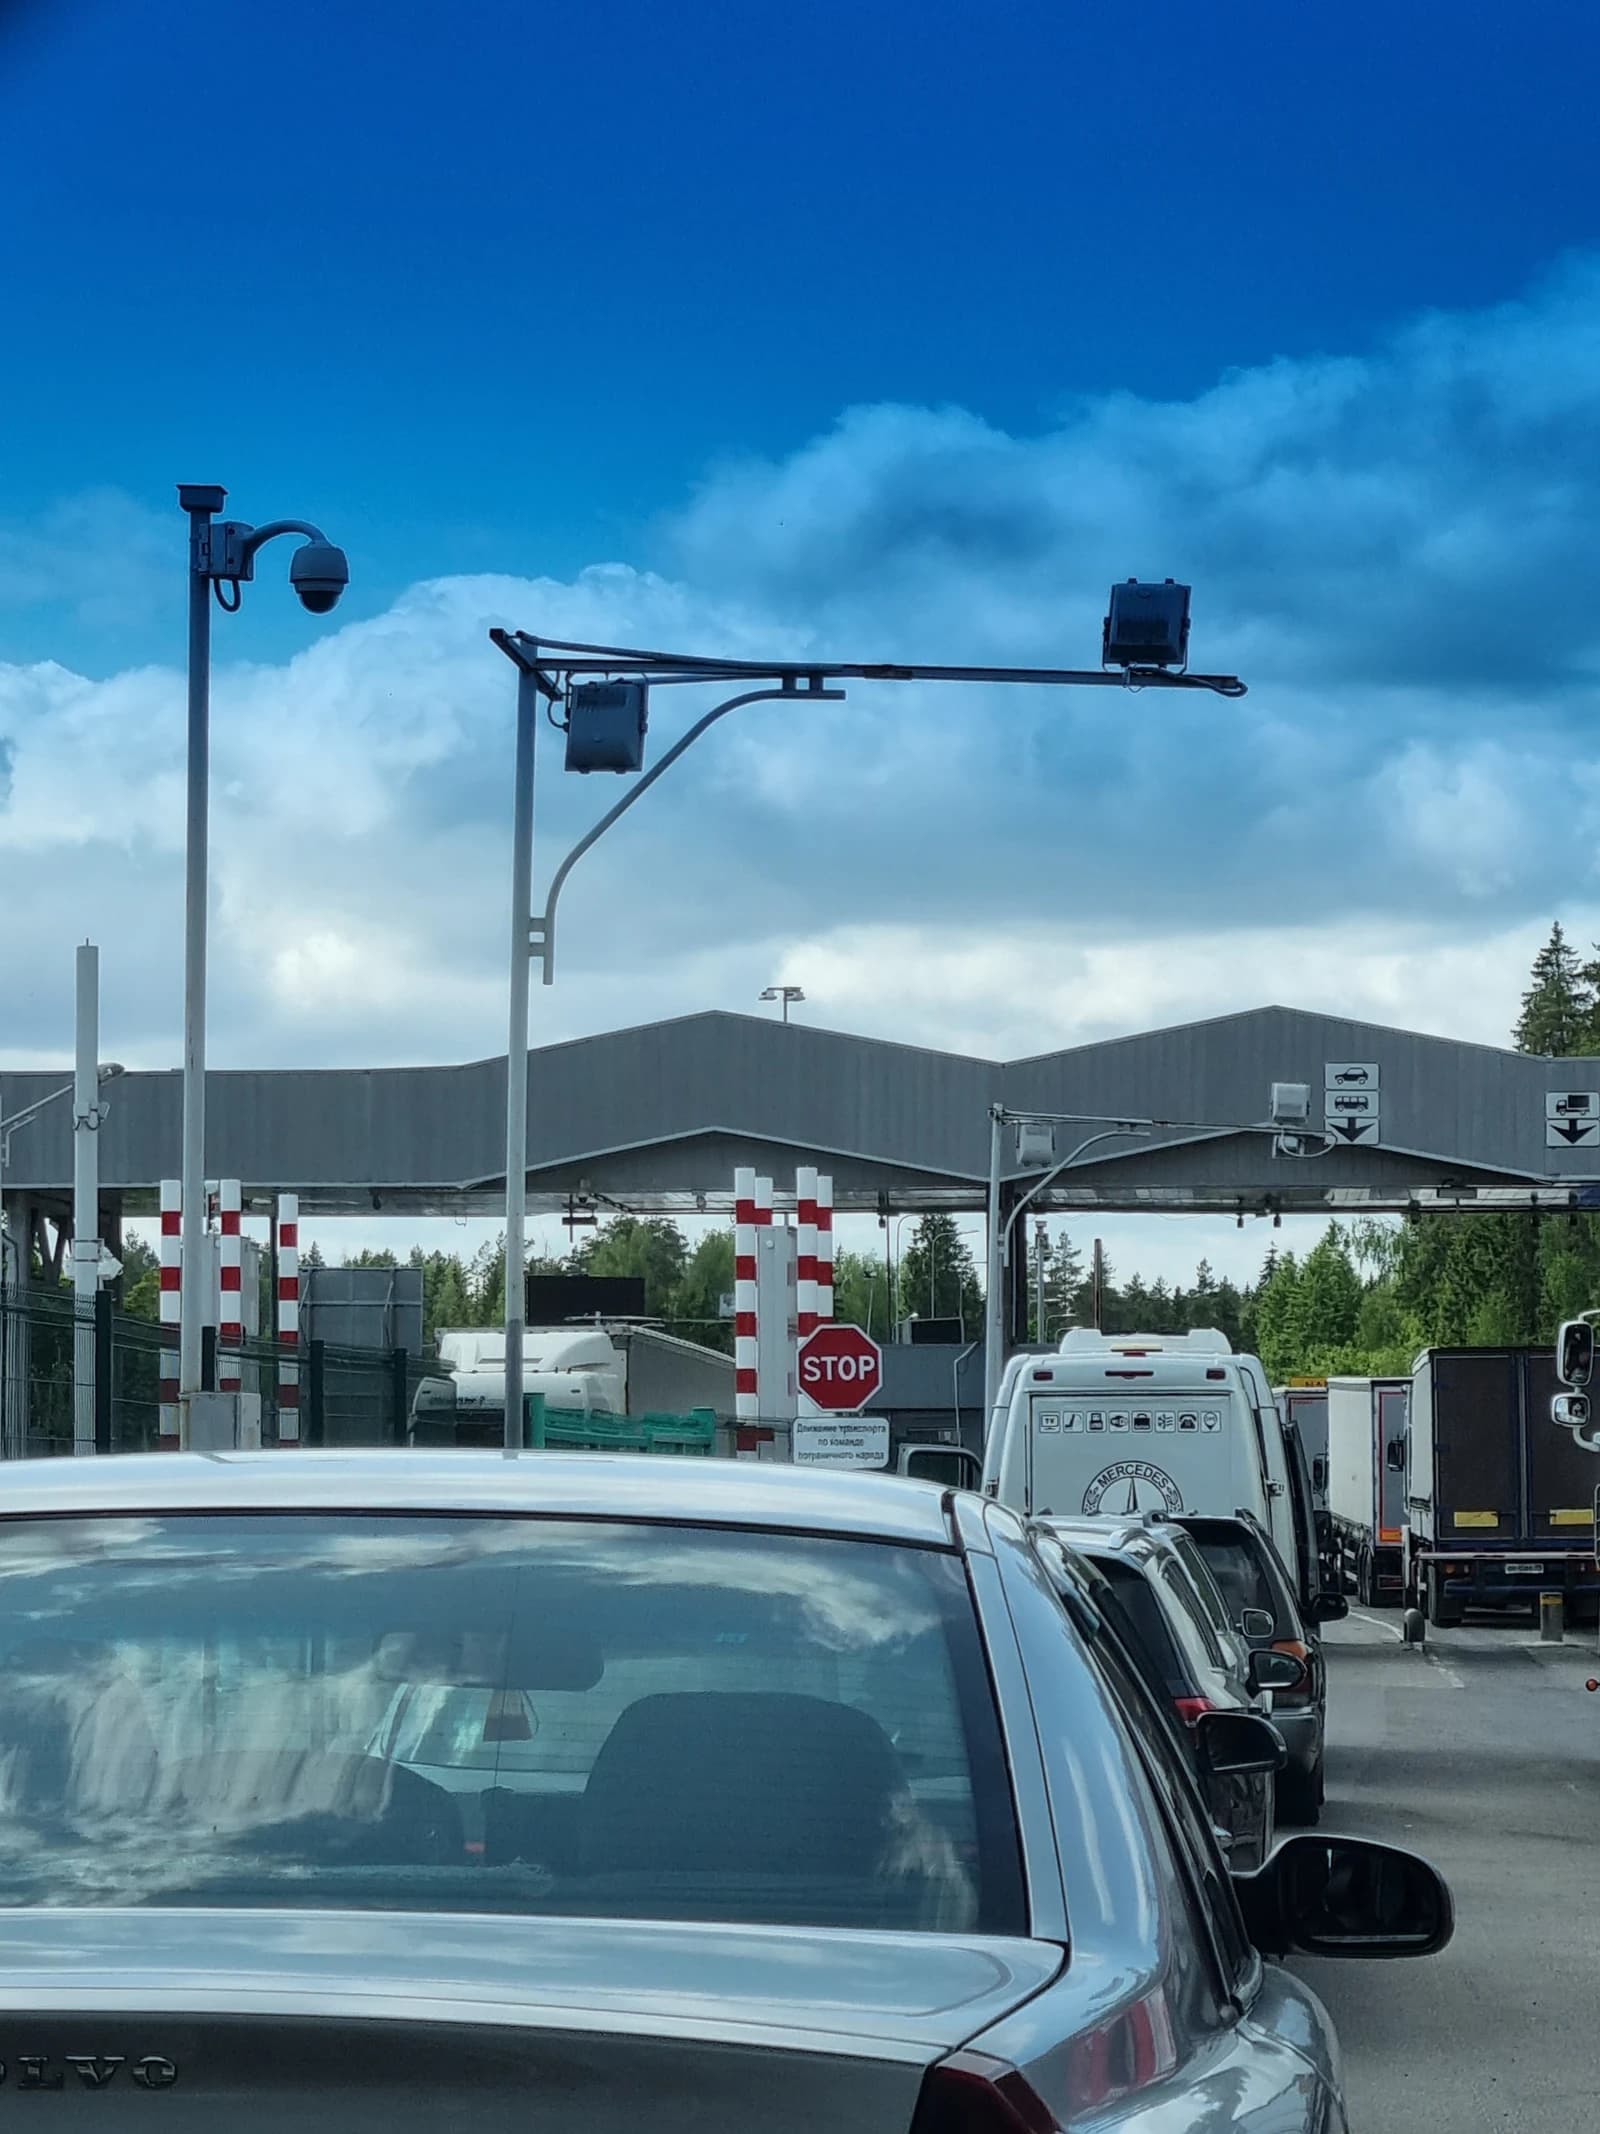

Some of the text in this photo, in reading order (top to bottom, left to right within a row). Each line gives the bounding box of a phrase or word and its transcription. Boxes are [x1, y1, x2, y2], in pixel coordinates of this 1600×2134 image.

[804, 1356, 875, 1382] STOP
[796, 1423, 887, 1435] Движение транспорта
[1044, 1417, 1055, 1425] TV
[817, 1438, 865, 1447] по команде
[1097, 1463, 1170, 1489] MERCEDES
[0, 2055, 179, 2090] LVO
